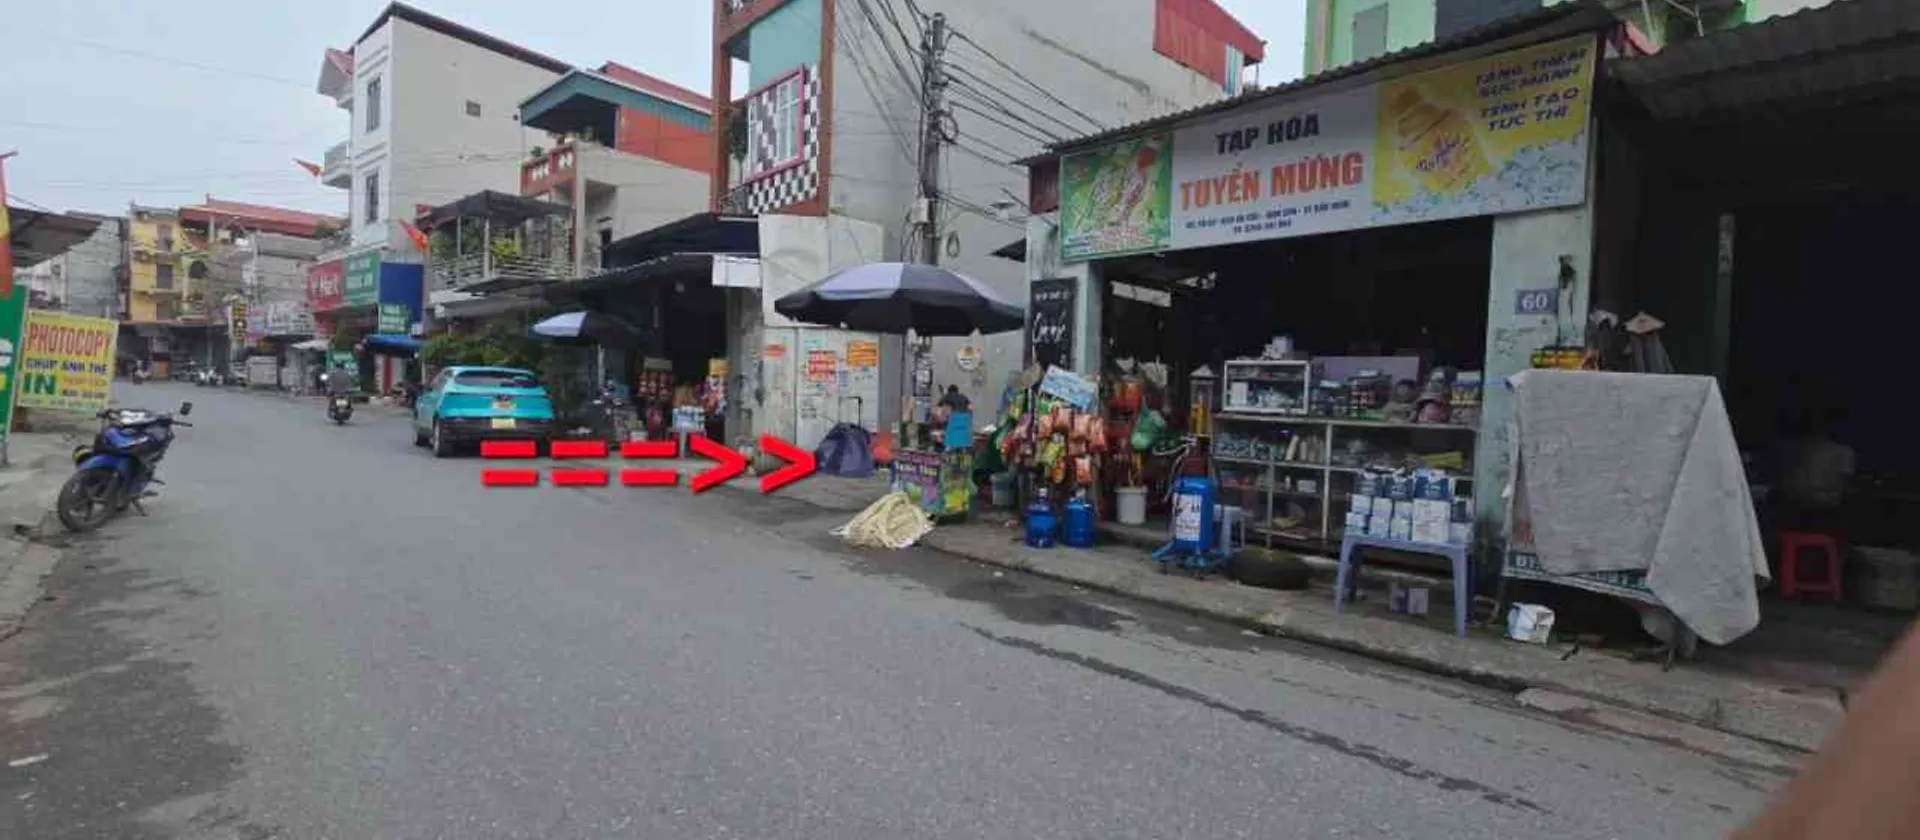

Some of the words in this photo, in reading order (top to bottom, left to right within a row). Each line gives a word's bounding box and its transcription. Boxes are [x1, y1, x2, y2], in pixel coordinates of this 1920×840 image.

[1180, 161, 1260, 211] TUYỂN
[1270, 151, 1364, 197] MỪNG
[1521, 293, 1547, 311] 60
[27, 323, 110, 358] PHOTOCOPY
[23, 372, 57, 395] IN
